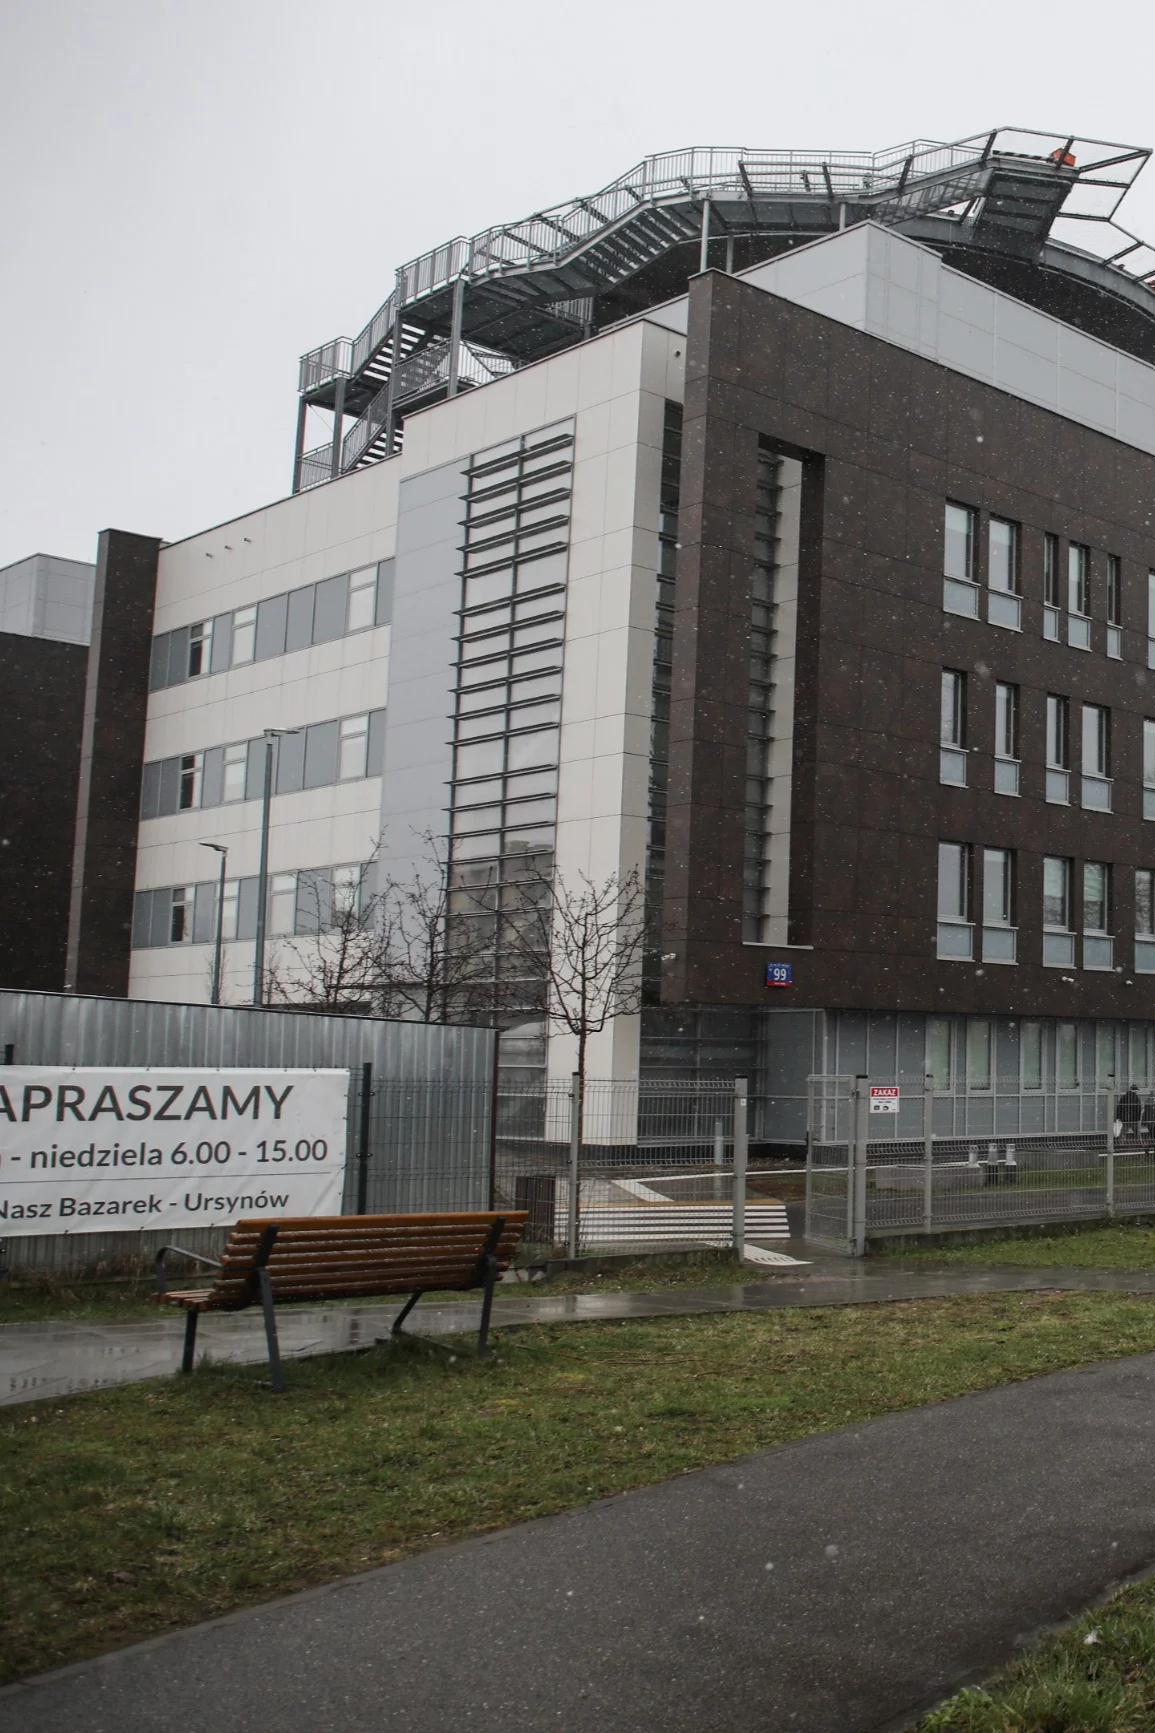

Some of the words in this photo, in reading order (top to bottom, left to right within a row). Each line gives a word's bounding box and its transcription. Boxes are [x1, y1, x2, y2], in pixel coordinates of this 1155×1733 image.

[773, 968, 787, 981] 99
[873, 1088, 896, 1096] ZAKAZ
[30, 1141, 164, 1168] niedziela
[170, 1140, 231, 1165] 6.00
[256, 1138, 328, 1163] 15.00
[59, 1194, 162, 1217] Bazarek
[184, 1189, 289, 1214] Ursynów
